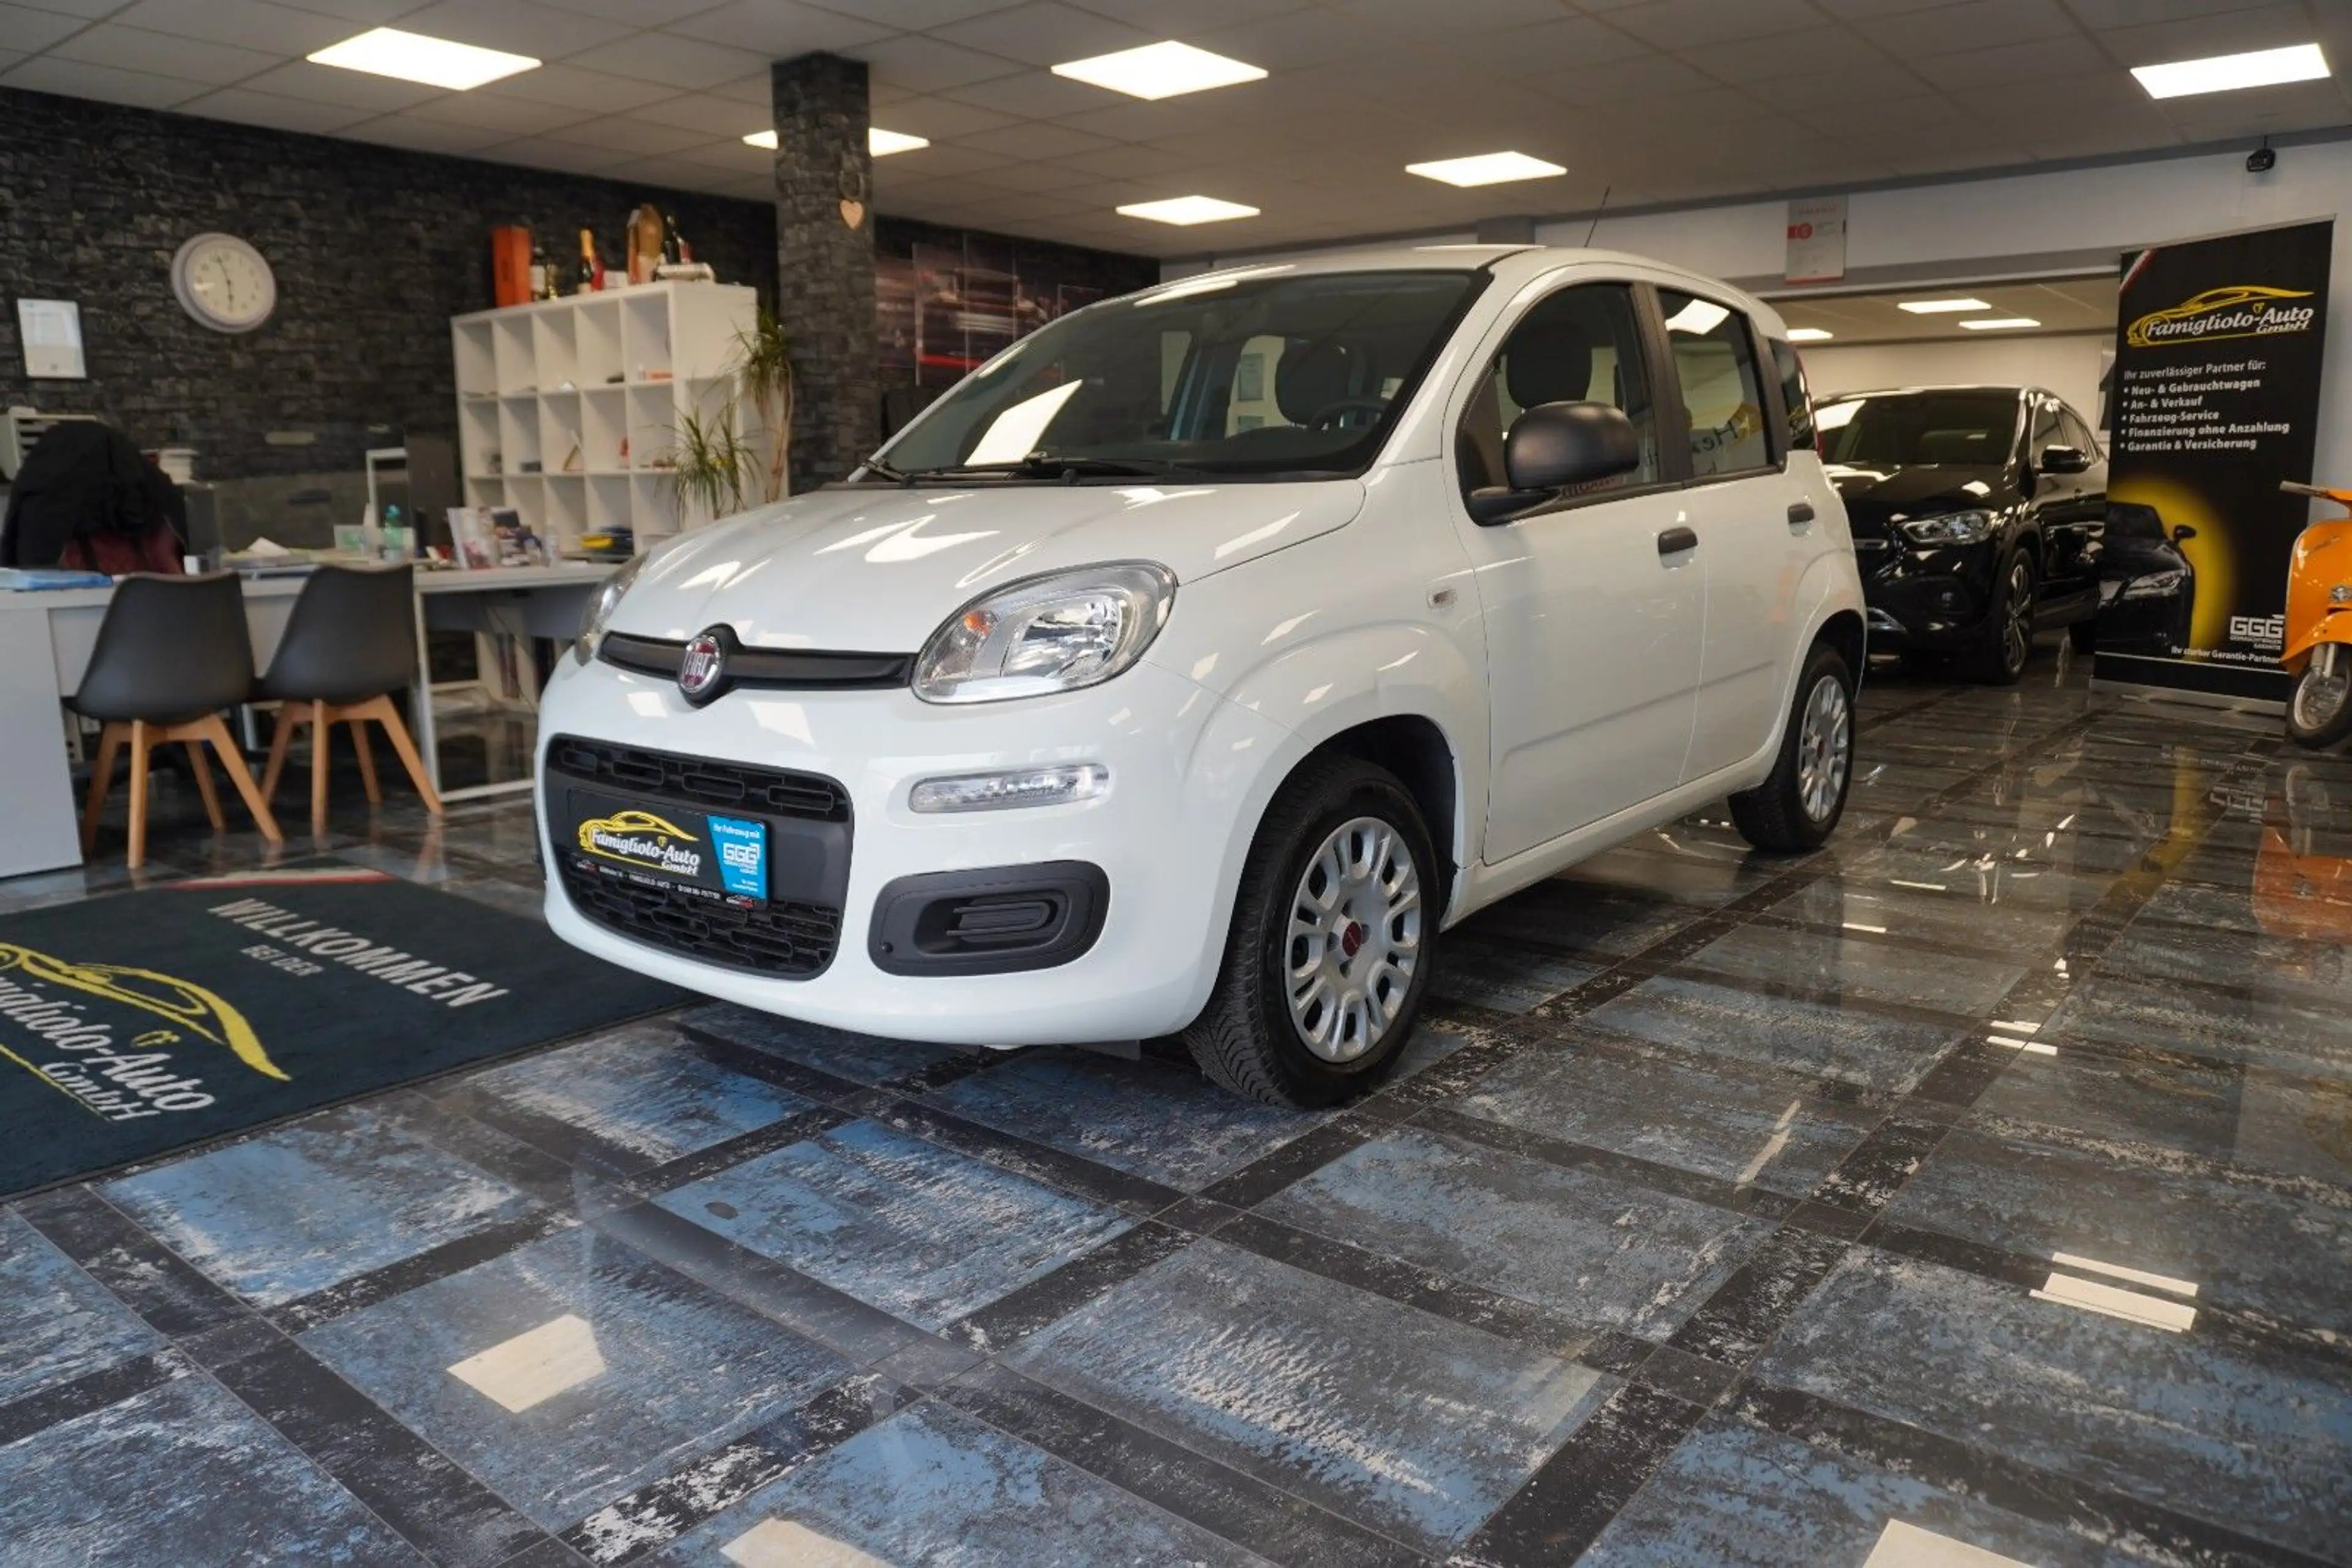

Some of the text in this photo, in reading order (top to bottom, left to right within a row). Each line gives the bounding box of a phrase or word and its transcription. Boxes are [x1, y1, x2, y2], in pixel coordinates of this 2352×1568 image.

[2147, 307, 2314, 336] Famigliolo-Auto
[2255, 320, 2310, 334] GmbH
[2124, 360, 2266, 380] Ihr zuverlässiger Partner für:
[2131, 379, 2261, 396] Neu- & Gebrauchtwagen
[2130, 395, 2203, 410] An- & Verkauf
[2129, 410, 2220, 424] Fahrzeug-Service
[2128, 421, 2290, 437] Finanzierung ohne Anzahlung
[2127, 439, 2258, 451] Garantie & Versicherung
[2211, 649, 2282, 664] Garantie-Partner
[592, 828, 701, 866] Famigliolo-Auto
[207, 897, 510, 1008] WILLKOMMEN
[239, 944, 324, 976] BEI DER
[40, 1061, 160, 1121] GmbH
